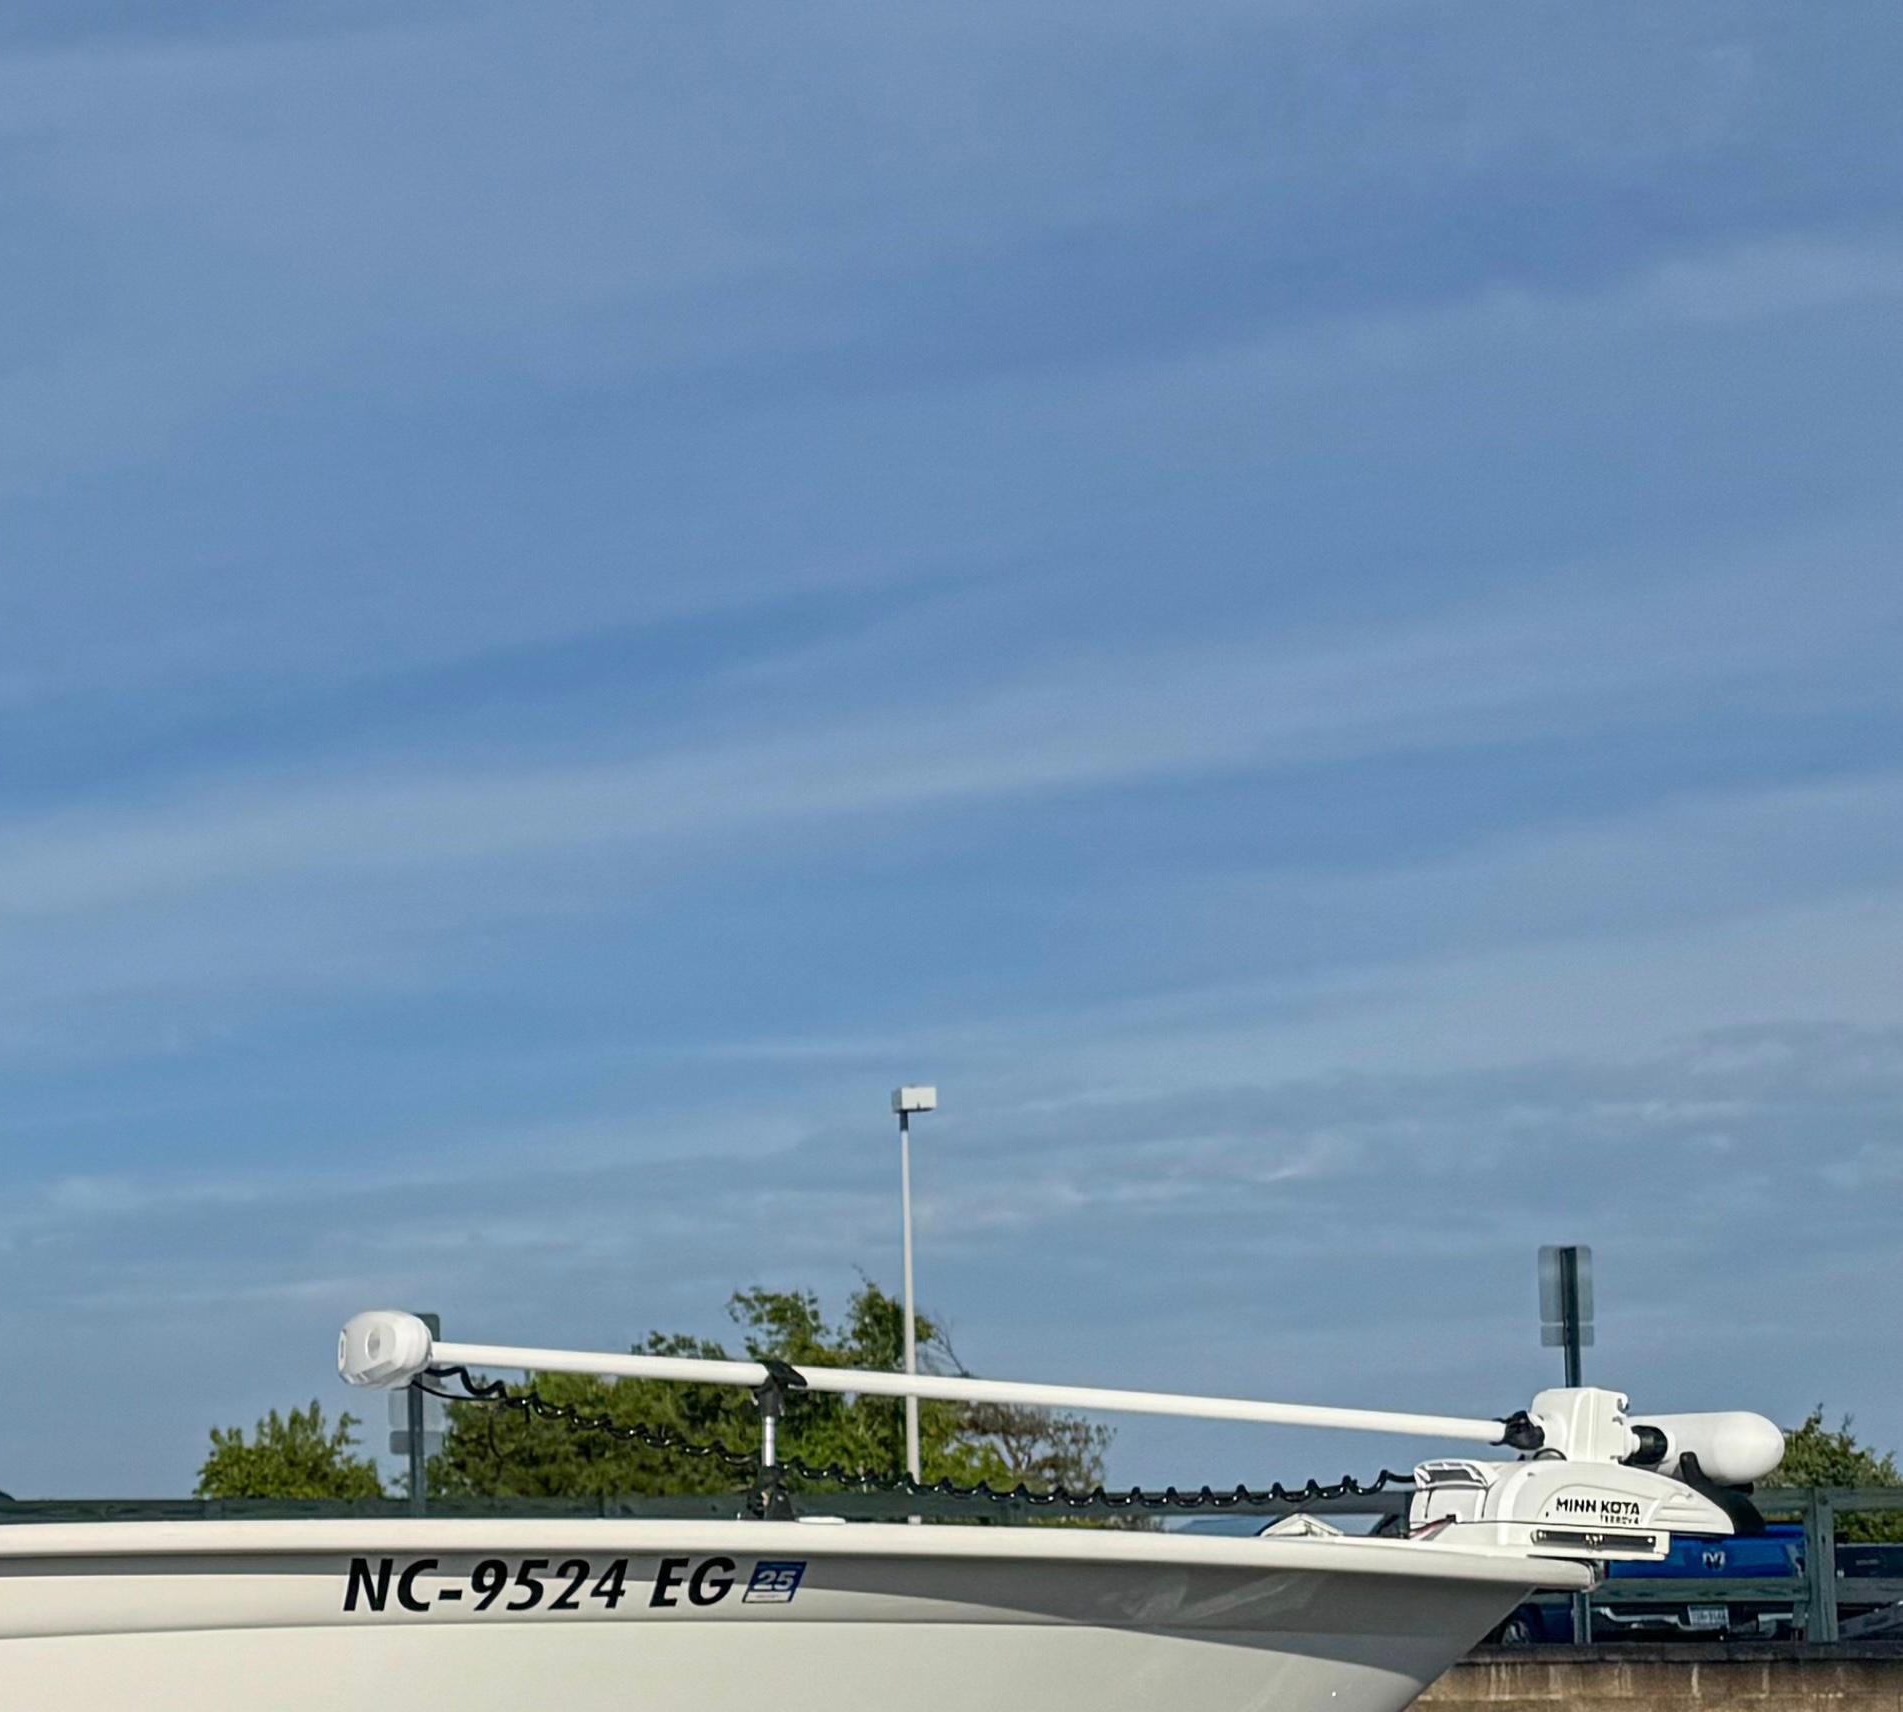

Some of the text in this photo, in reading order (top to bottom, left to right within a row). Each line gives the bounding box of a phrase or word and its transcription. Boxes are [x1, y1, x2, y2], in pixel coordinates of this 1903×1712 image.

[1556, 1497, 1640, 1515] MINN KOTA
[342, 1557, 736, 1612] NC-9524 EG
[753, 1570, 796, 1590] 25
